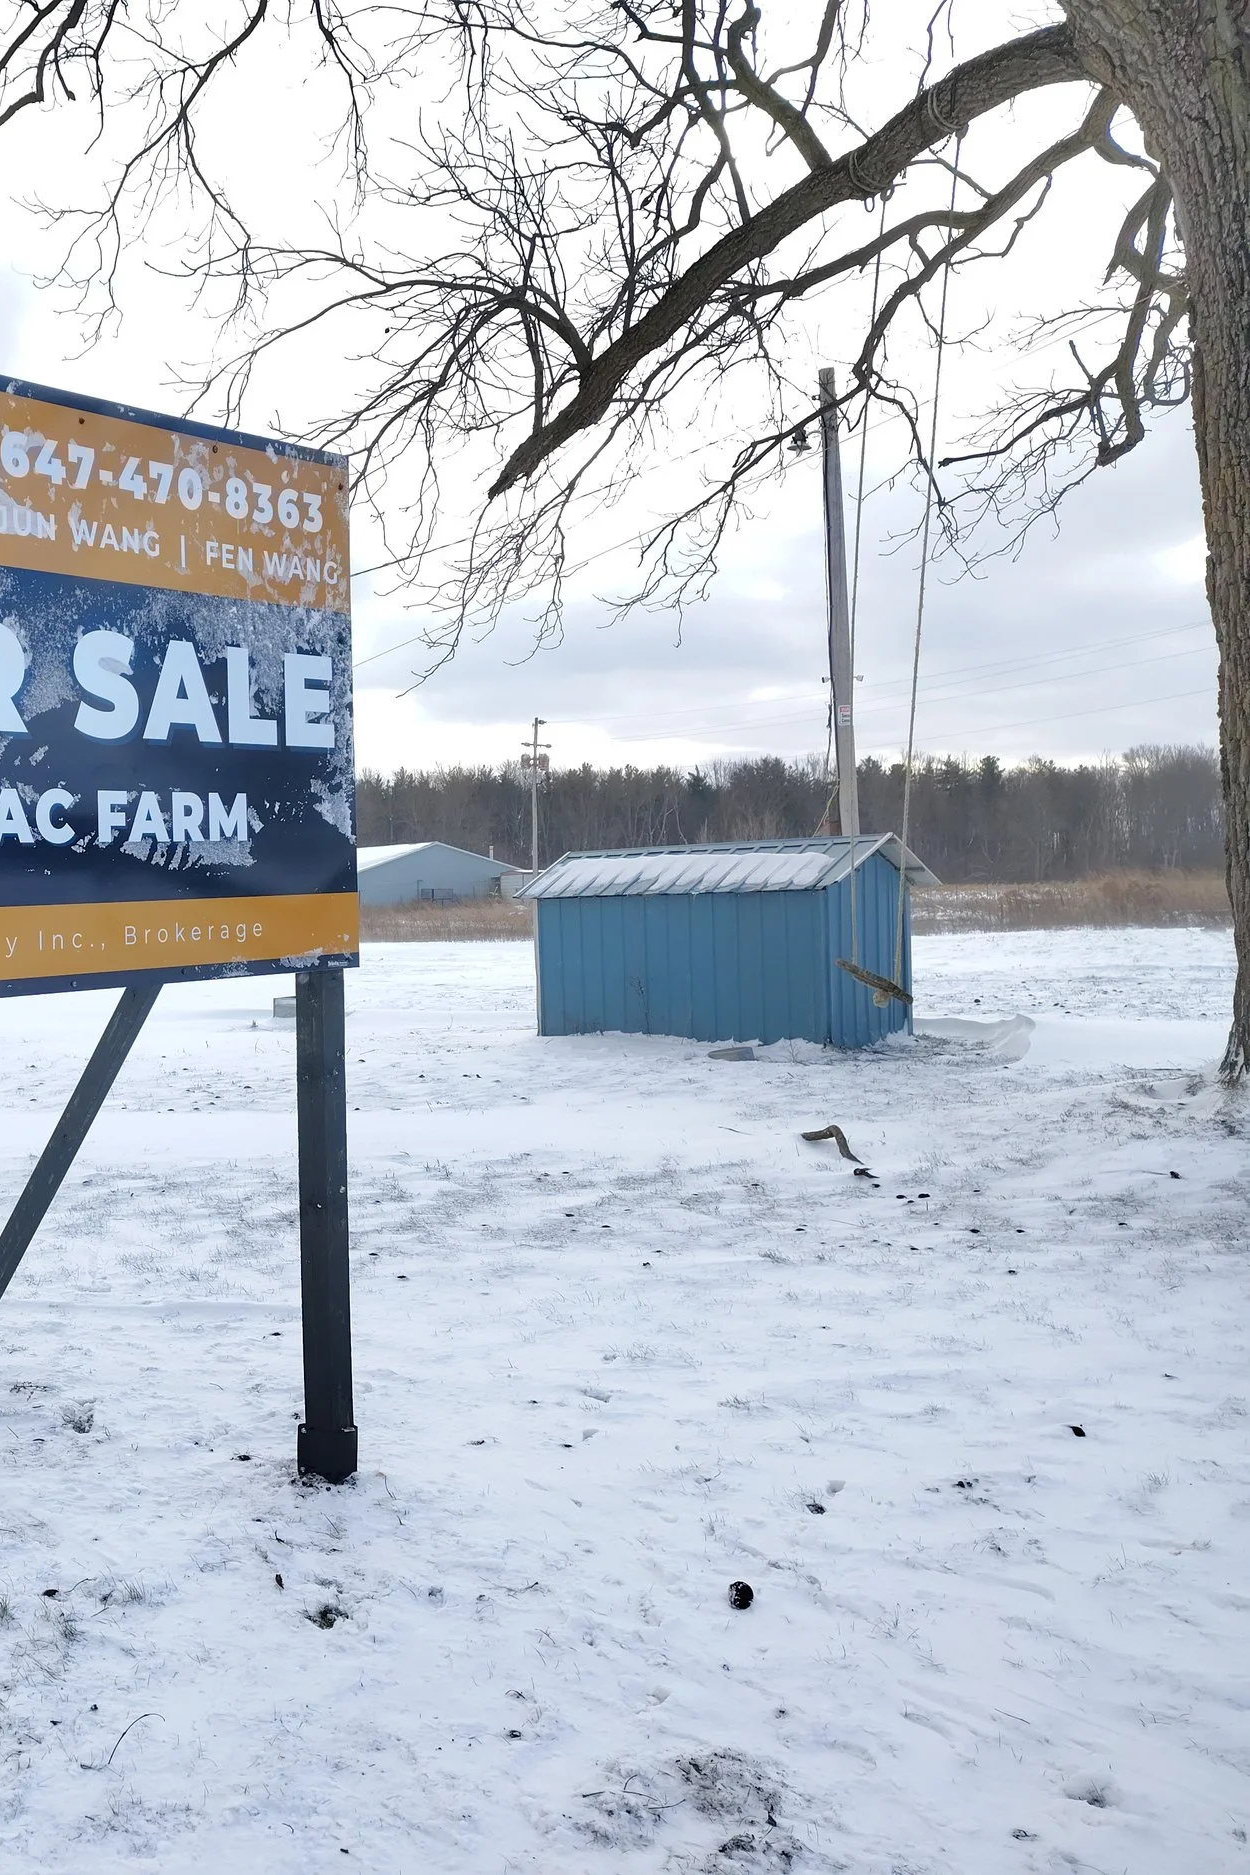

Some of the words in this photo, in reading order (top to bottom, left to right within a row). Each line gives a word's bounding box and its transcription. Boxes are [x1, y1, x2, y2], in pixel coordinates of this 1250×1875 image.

[0, 431, 324, 533] 647-470-8363
[71, 519, 160, 557] WANG
[206, 540, 253, 573] FEN
[263, 550, 339, 585] WANG
[72, 630, 336, 749] SALE
[97, 790, 249, 844] FARM
[37, 928, 106, 952] Inc.,
[124, 919, 265, 946] Brokerage
